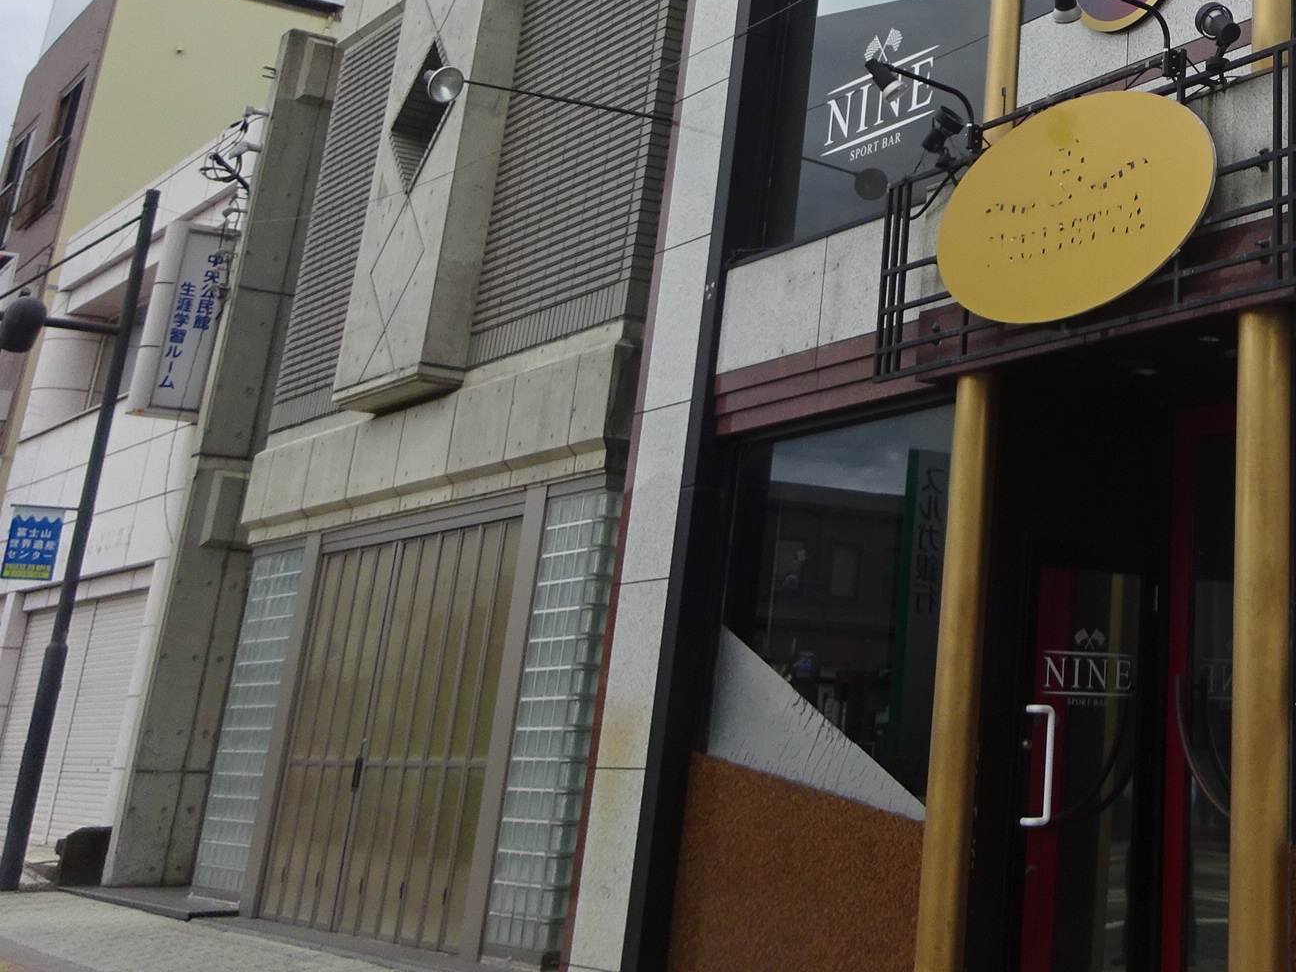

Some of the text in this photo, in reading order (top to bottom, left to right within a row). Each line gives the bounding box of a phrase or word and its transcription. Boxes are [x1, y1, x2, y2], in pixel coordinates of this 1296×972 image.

[849, 132, 901, 162] SPORT BAR
[192, 254, 224, 331] 中央公民館
[158, 281, 197, 389] 生涯学習ルーム
[7, 550, 53, 561] センター
[1043, 656, 1132, 691] NINE
